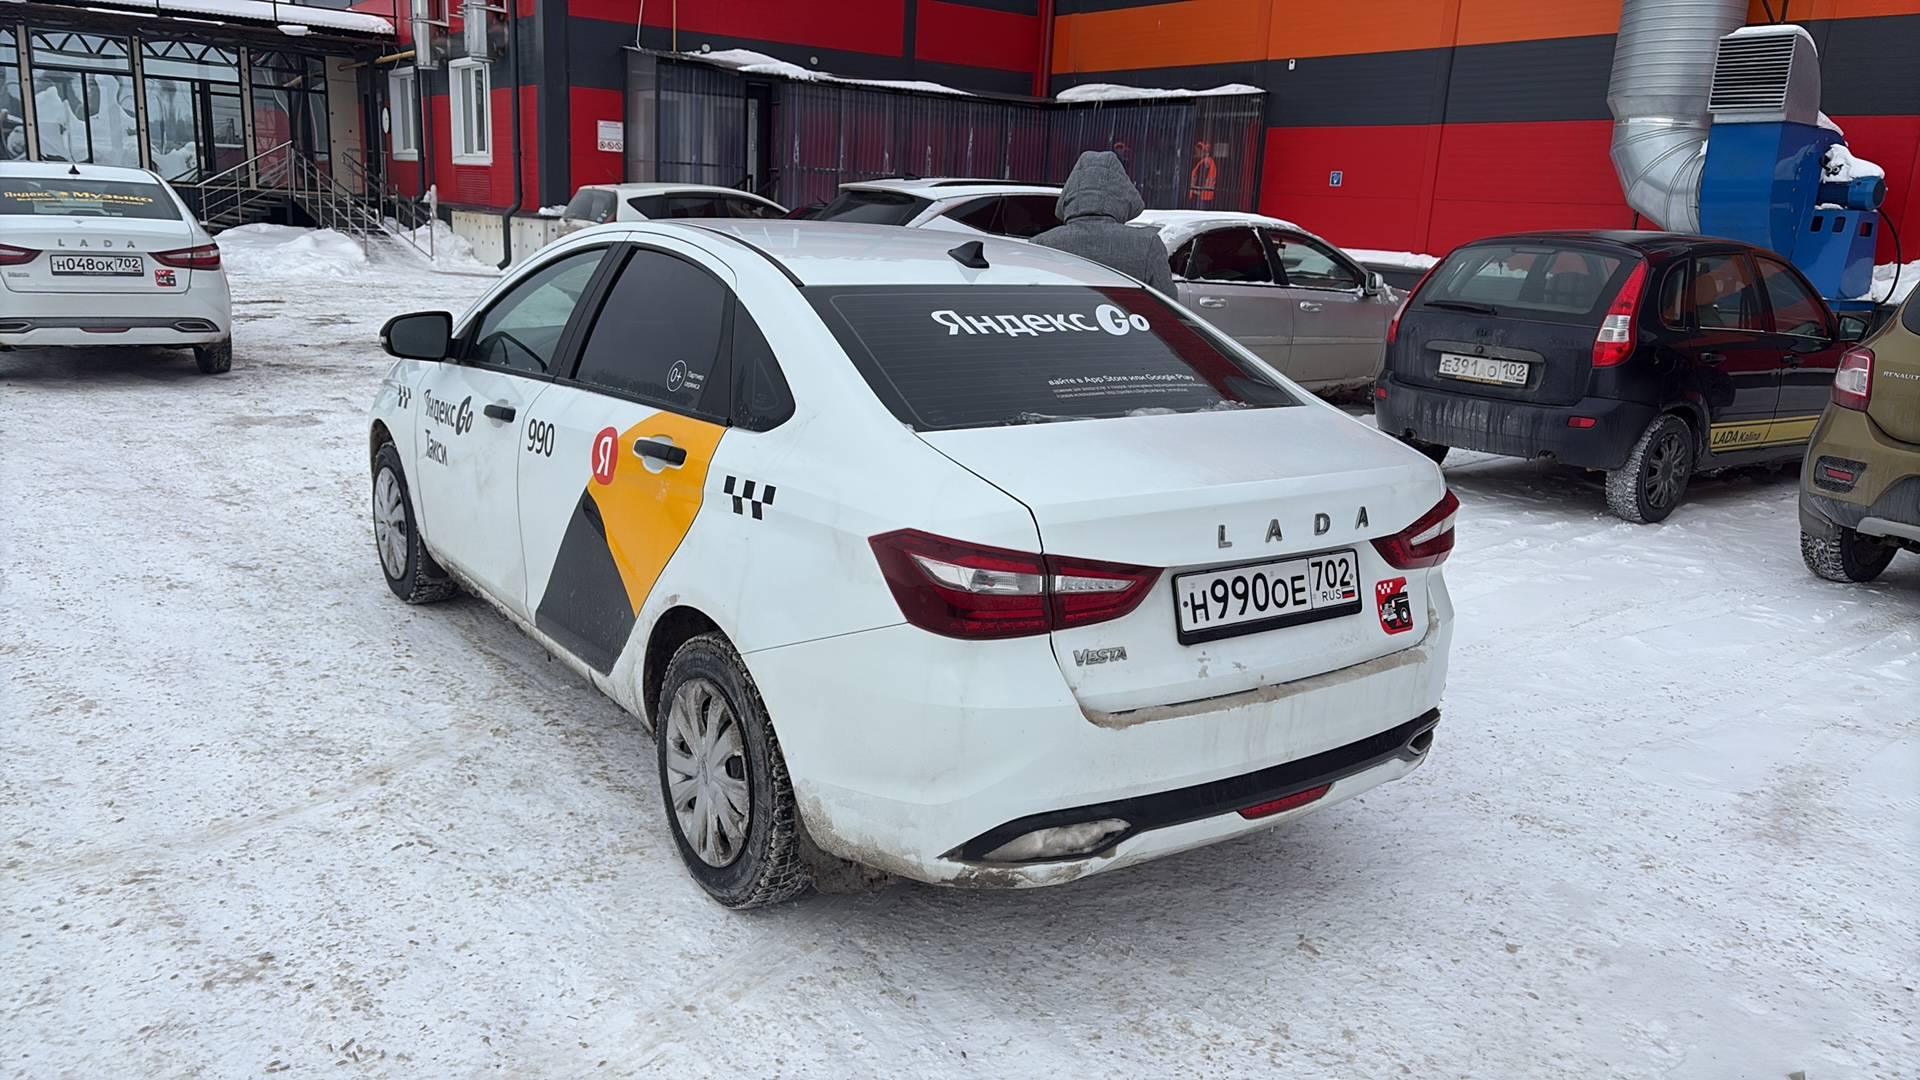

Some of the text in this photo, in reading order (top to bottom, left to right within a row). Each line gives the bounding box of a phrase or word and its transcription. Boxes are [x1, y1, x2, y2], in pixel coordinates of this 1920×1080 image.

[3, 191, 51, 199] Яндекс
[73, 191, 153, 203] Музыка
[58, 238, 136, 249] LADA
[57, 258, 138, 271] Н048ОК 702
[931, 303, 1150, 337] Яндекс Go
[1084, 376, 1104, 384] App
[1103, 375, 1128, 383] Store
[1145, 373, 1176, 381] Google
[1175, 373, 1195, 382] Play
[1502, 362, 1525, 378] 102
[1883, 370, 1920, 381] RENAULT
[424, 388, 474, 436] Яндекс Go
[527, 418, 555, 458] 990
[1712, 430, 1761, 445] LADA Kalina
[424, 429, 448, 467] Такси
[596, 435, 613, 477] Я
[1217, 506, 1369, 549] LADA
[1189, 558, 1350, 624] Н990ОЕ 702
[1321, 590, 1342, 602] RUS
[1073, 646, 1127, 667] VESTA
